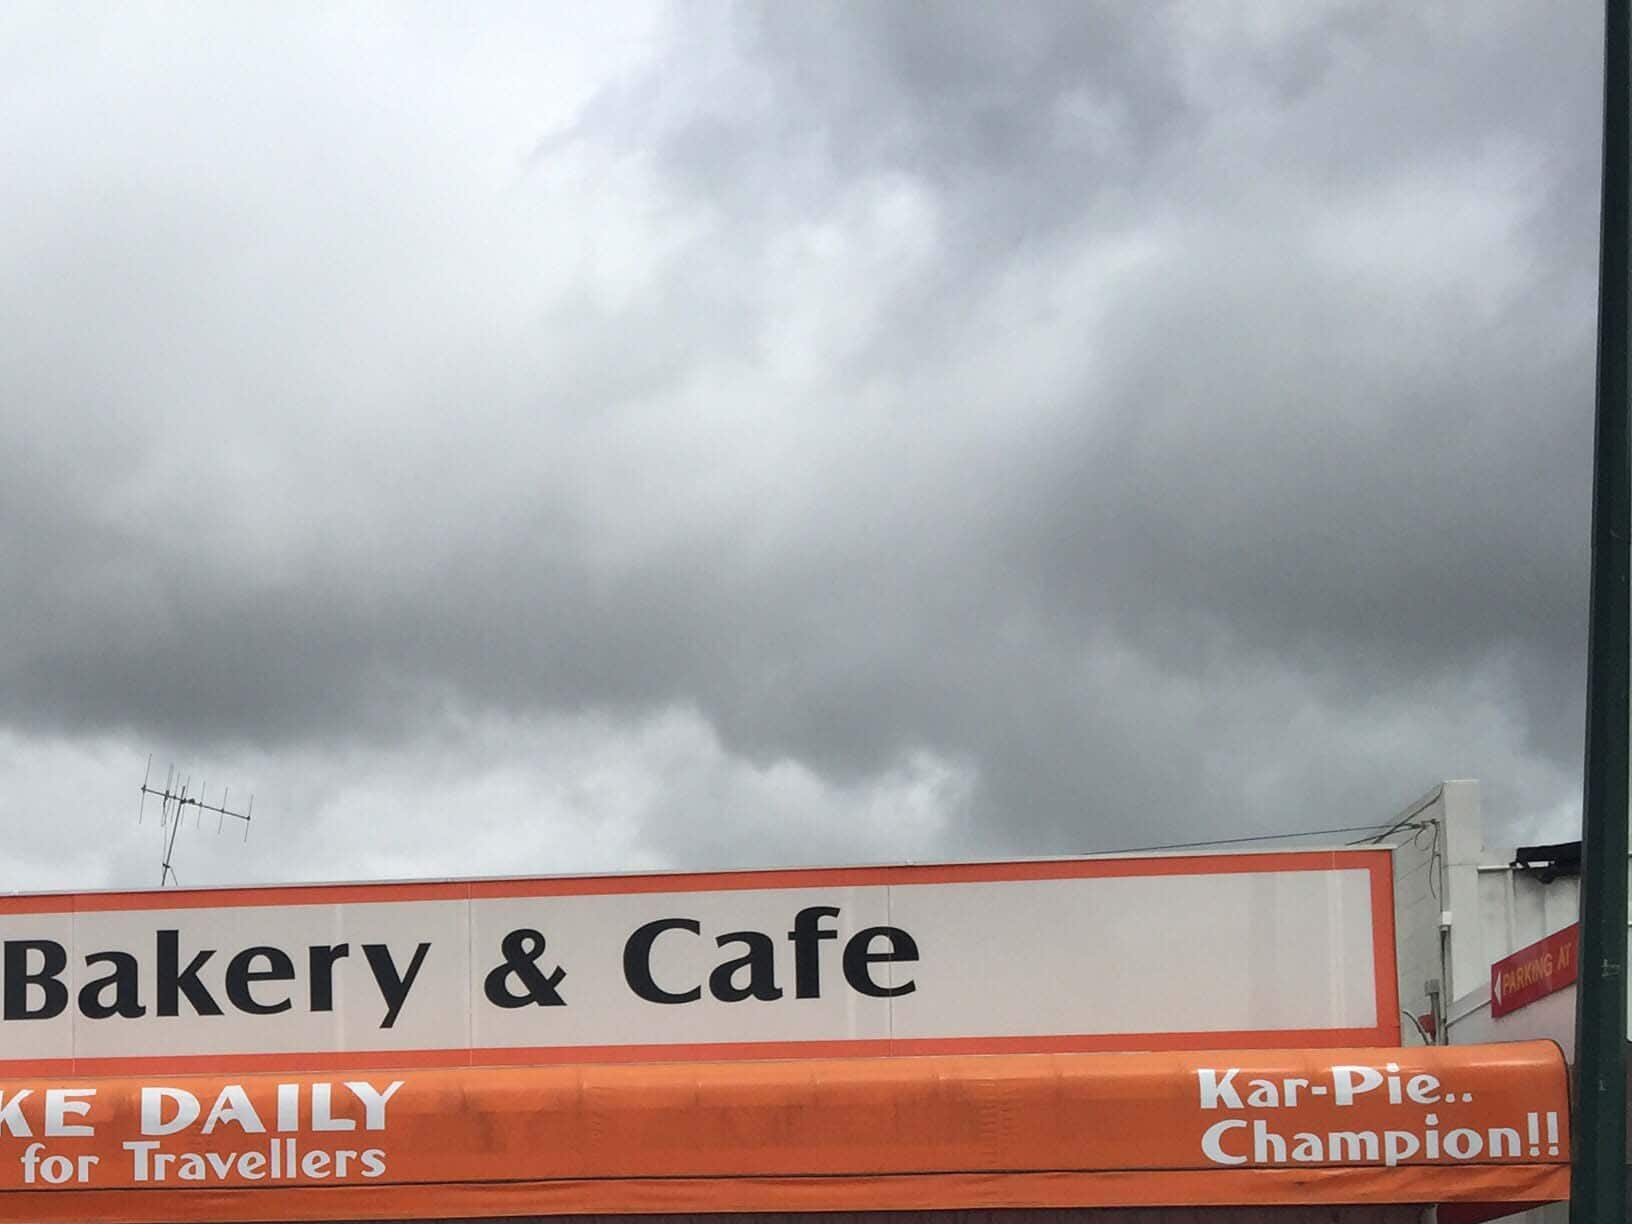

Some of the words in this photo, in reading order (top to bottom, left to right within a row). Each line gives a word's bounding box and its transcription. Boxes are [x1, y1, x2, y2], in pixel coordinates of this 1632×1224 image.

[2, 928, 432, 1029] Bakery
[483, 928, 567, 1008] &
[622, 906, 920, 1004] Cafe
[1503, 953, 1553, 996] PARKING
[1557, 943, 1573, 972] AT
[141, 1081, 405, 1136] DAILY
[1197, 1063, 1473, 1110] Kar-Pie..
[21, 1143, 100, 1184] for
[122, 1138, 387, 1182] Travellers
[1200, 1112, 1560, 1167] Champion!!
